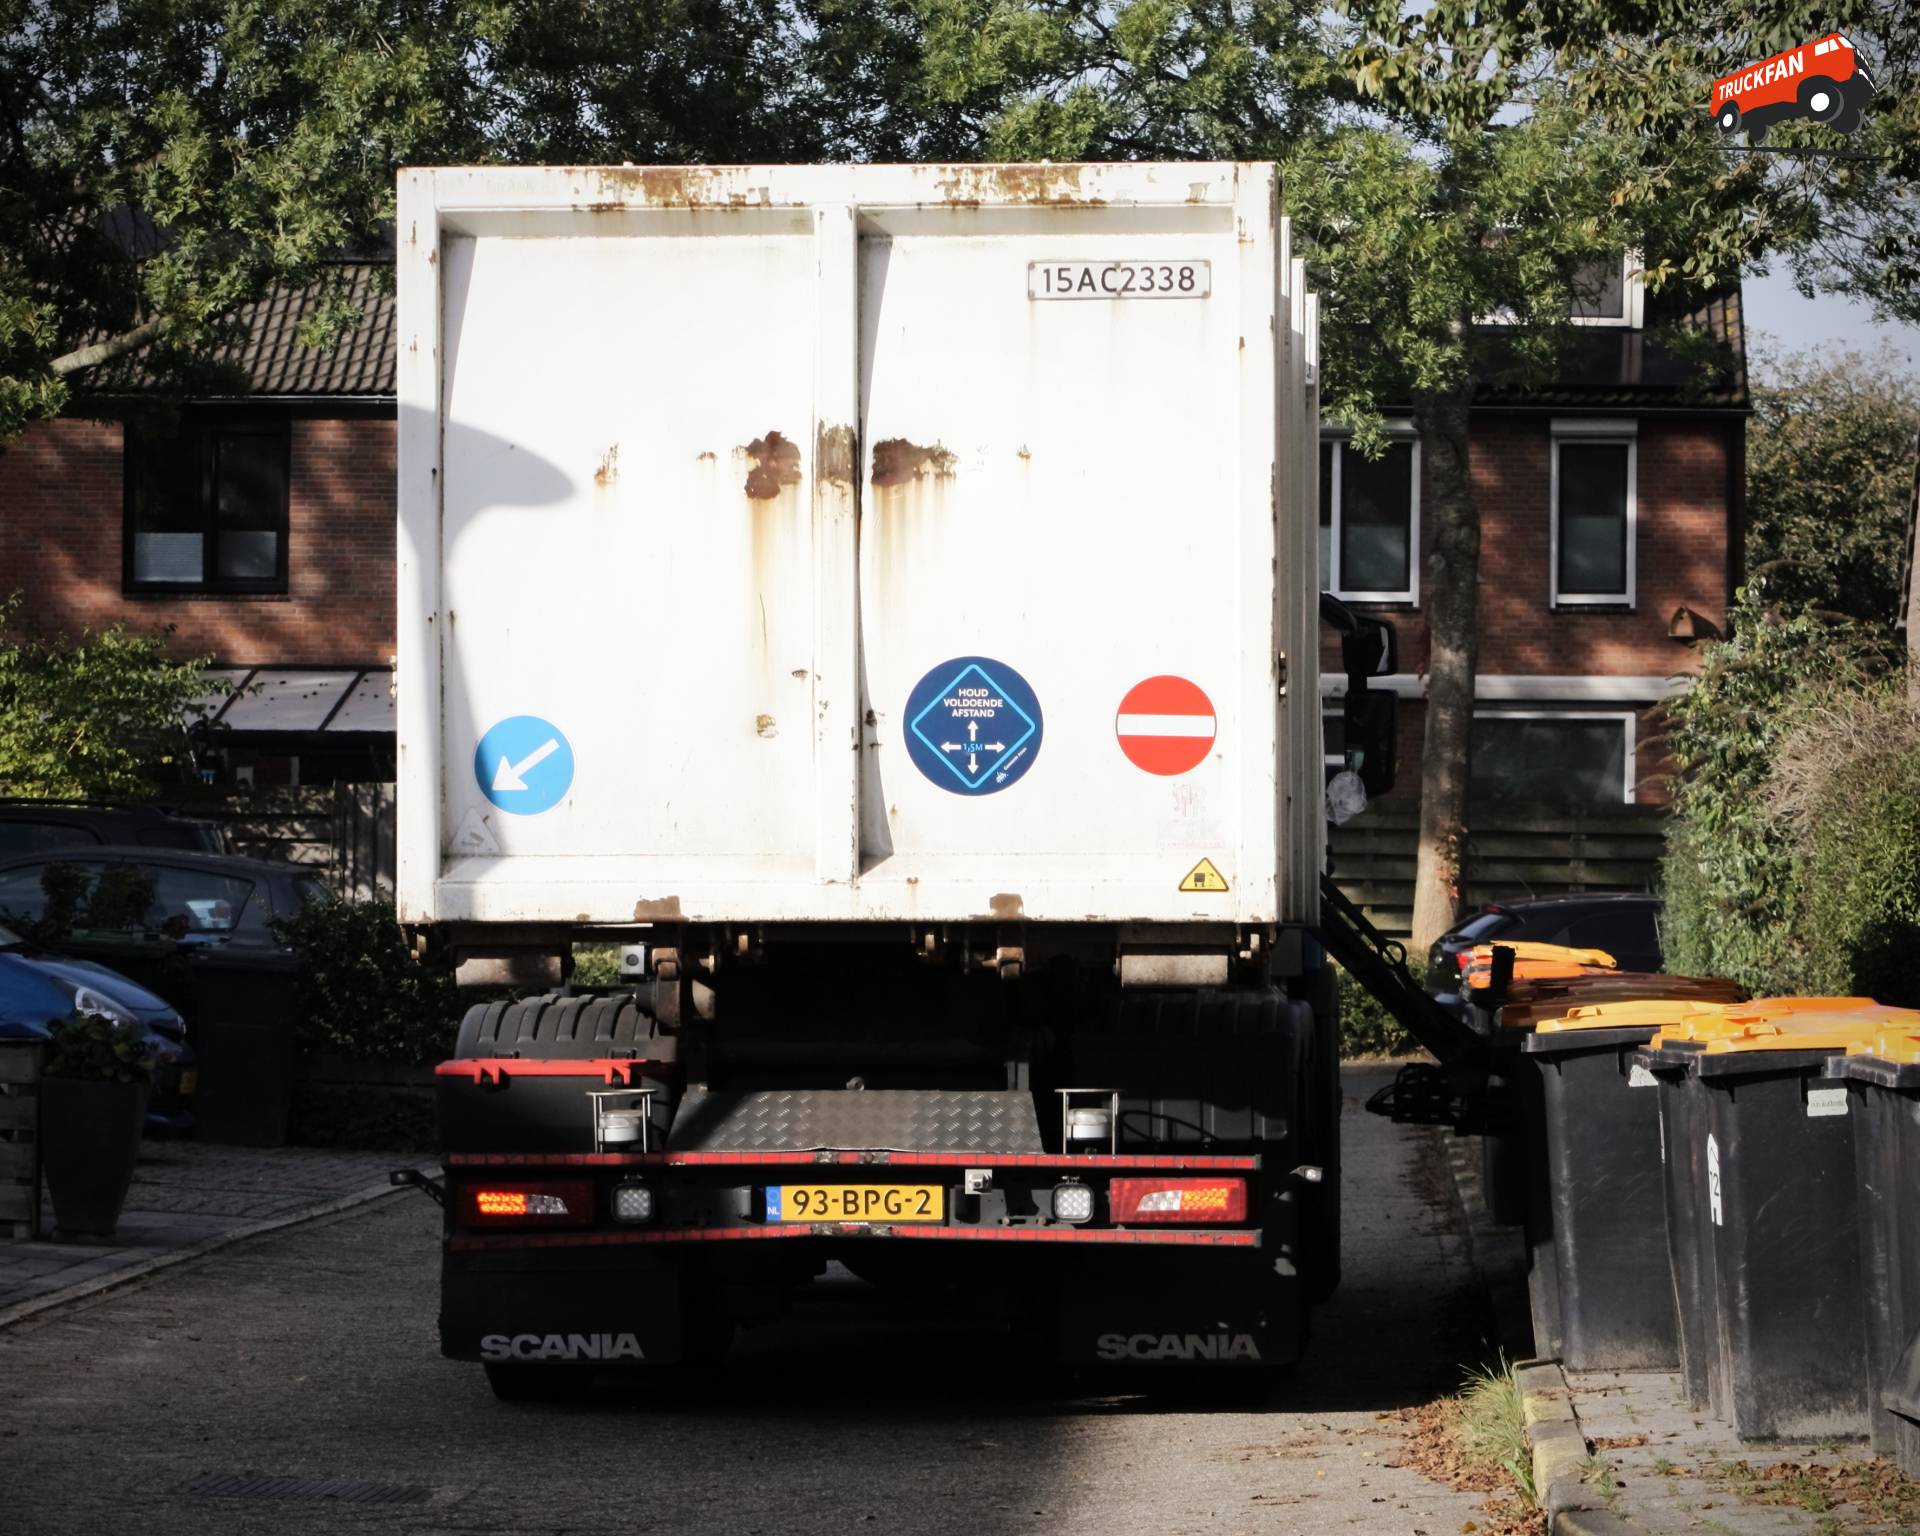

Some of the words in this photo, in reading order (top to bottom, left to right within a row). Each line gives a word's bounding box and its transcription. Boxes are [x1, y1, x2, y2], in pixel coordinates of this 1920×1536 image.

[1043, 266, 1195, 292] 15AC2338
[958, 688, 988, 697] HOUD
[943, 698, 1003, 708] VOLDOENDE
[952, 708, 995, 718] AFSTAND
[767, 1206, 780, 1215] NL
[792, 1189, 931, 1216] 93-BPG-2
[480, 1333, 645, 1360] SCANIA
[1097, 1333, 1262, 1360] SCANIA
